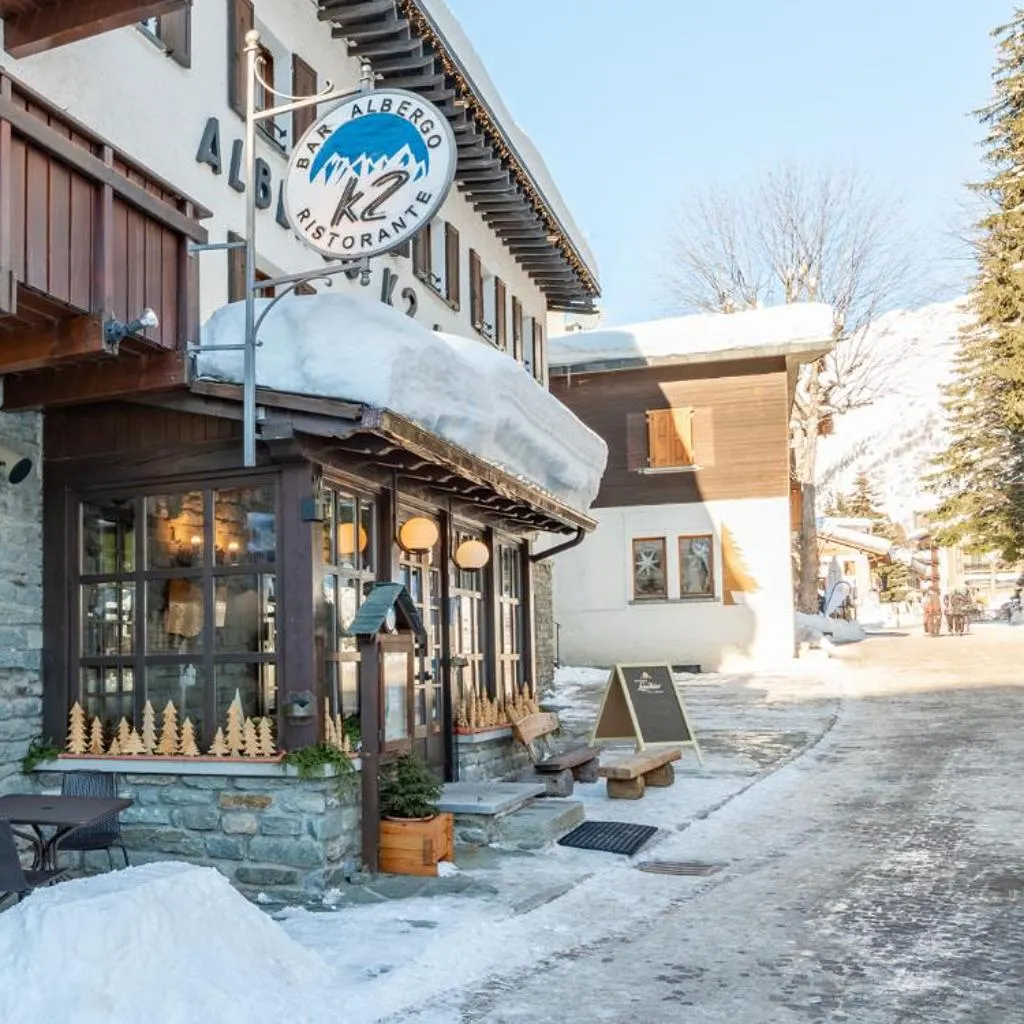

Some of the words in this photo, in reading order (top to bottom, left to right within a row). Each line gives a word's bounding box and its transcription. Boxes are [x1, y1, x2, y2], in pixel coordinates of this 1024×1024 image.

[296, 124, 333, 169] BAR
[350, 98, 442, 149] ALBERGO
[297, 191, 432, 250] RISTORANTE
[330, 170, 410, 227] K2
